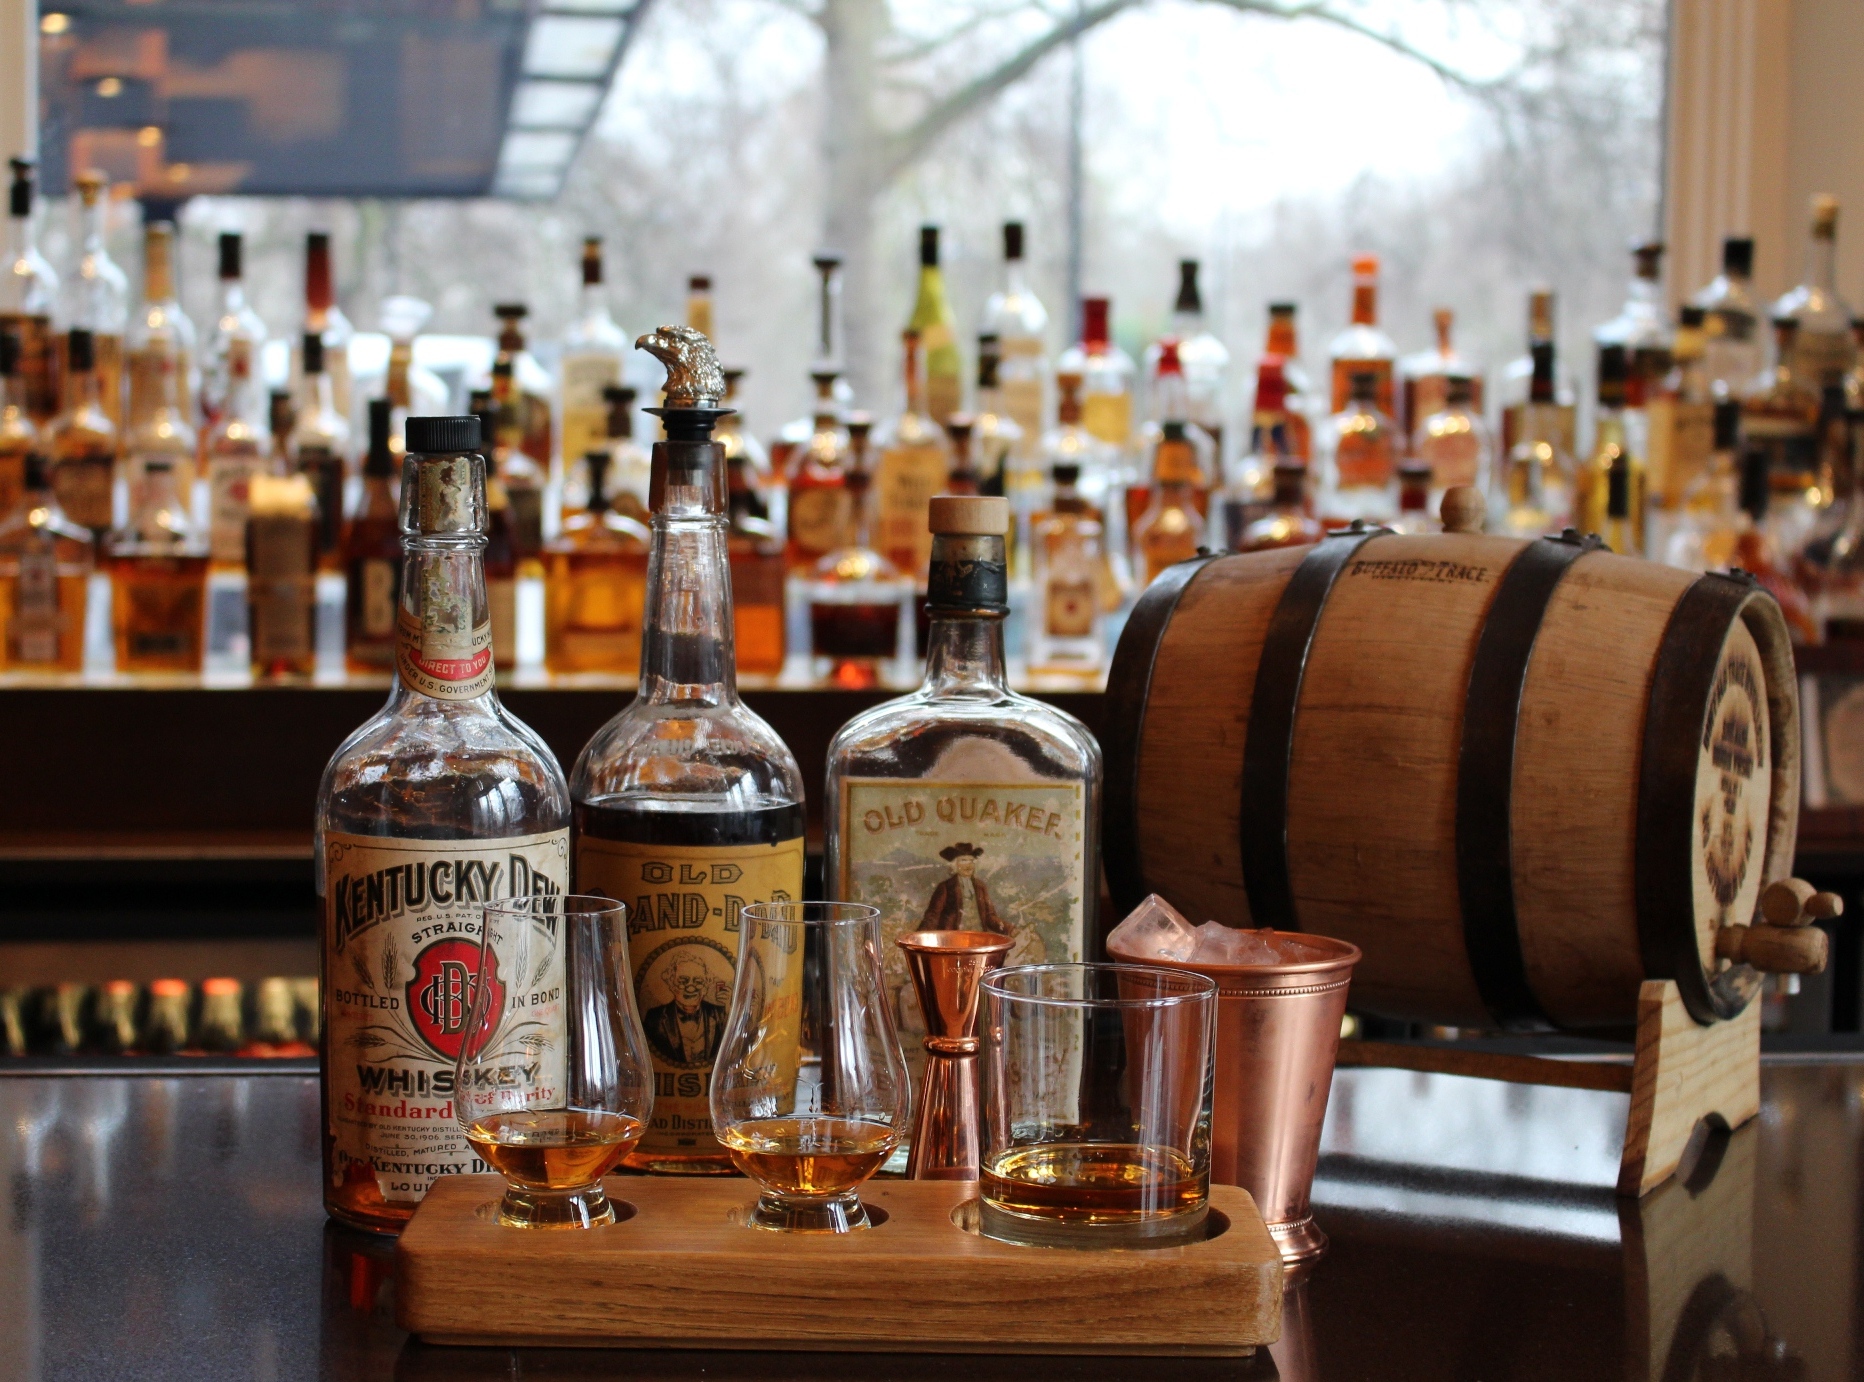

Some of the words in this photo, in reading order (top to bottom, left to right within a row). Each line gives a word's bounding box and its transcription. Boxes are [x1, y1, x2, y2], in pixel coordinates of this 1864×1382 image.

[401, 653, 419, 680] UNDER
[419, 677, 437, 691] U.S.
[439, 674, 490, 694] GOVERNMENT
[419, 660, 456, 674] DIRECT
[460, 663, 472, 674] TO
[473, 656, 486, 669] YOU
[863, 802, 925, 835] OLD
[642, 862, 744, 885] OLD
[335, 859, 503, 953] KENTUCKY
[509, 853, 561, 940] DEW
[336, 989, 400, 1010] BOTTLED
[512, 996, 525, 1008] IN
[531, 988, 560, 1005] BOND
[356, 1062, 541, 1098] WHISKEY
[344, 1092, 453, 1119] Standard
[379, 1123, 391, 1131] OLD
[393, 1125, 430, 1133] KENTUCKY
[365, 1143, 410, 1159] DISTILLED,
[413, 1144, 457, 1156] MATURED
[368, 1155, 467, 1175] KENTUCKY
